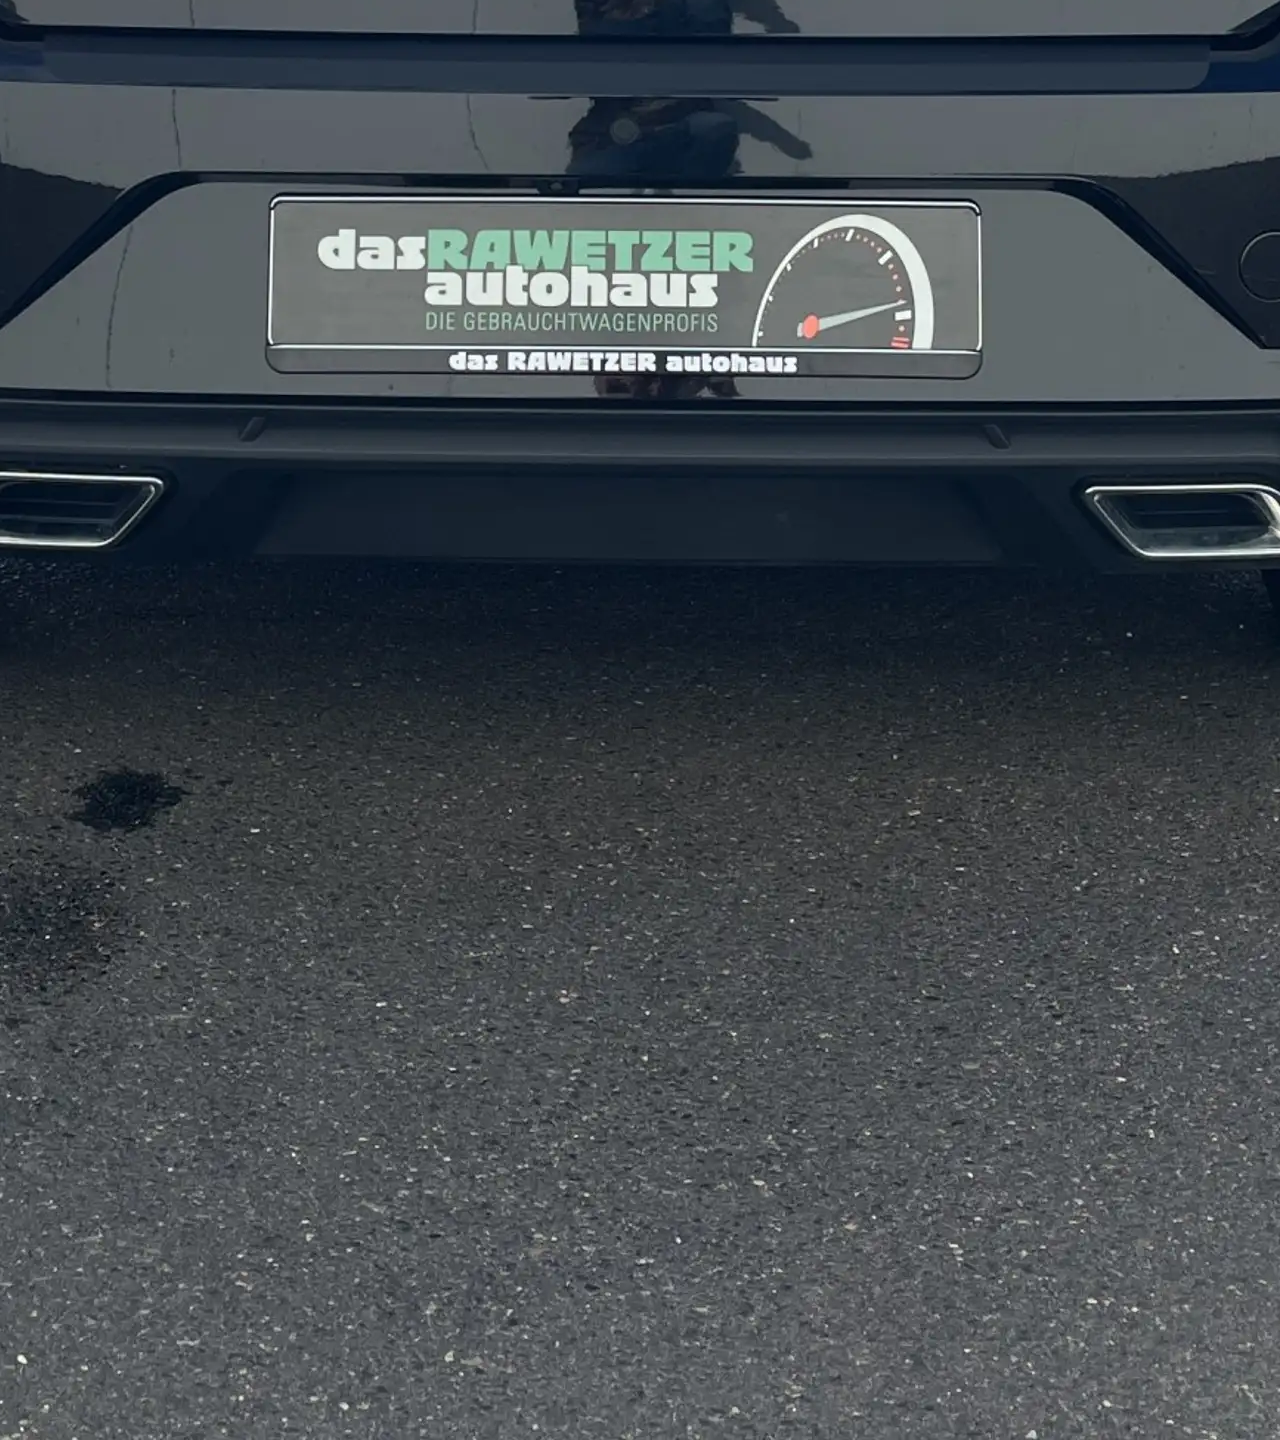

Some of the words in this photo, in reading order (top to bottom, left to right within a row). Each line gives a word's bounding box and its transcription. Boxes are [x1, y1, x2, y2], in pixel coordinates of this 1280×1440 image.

[424, 265, 718, 307] autohaus
[426, 312, 456, 330] DIE
[463, 312, 718, 332] GEBRAUCHTWAGENPROFIS
[448, 351, 498, 371] das
[507, 352, 657, 372] RAWETZER
[665, 352, 798, 373] autohaus
